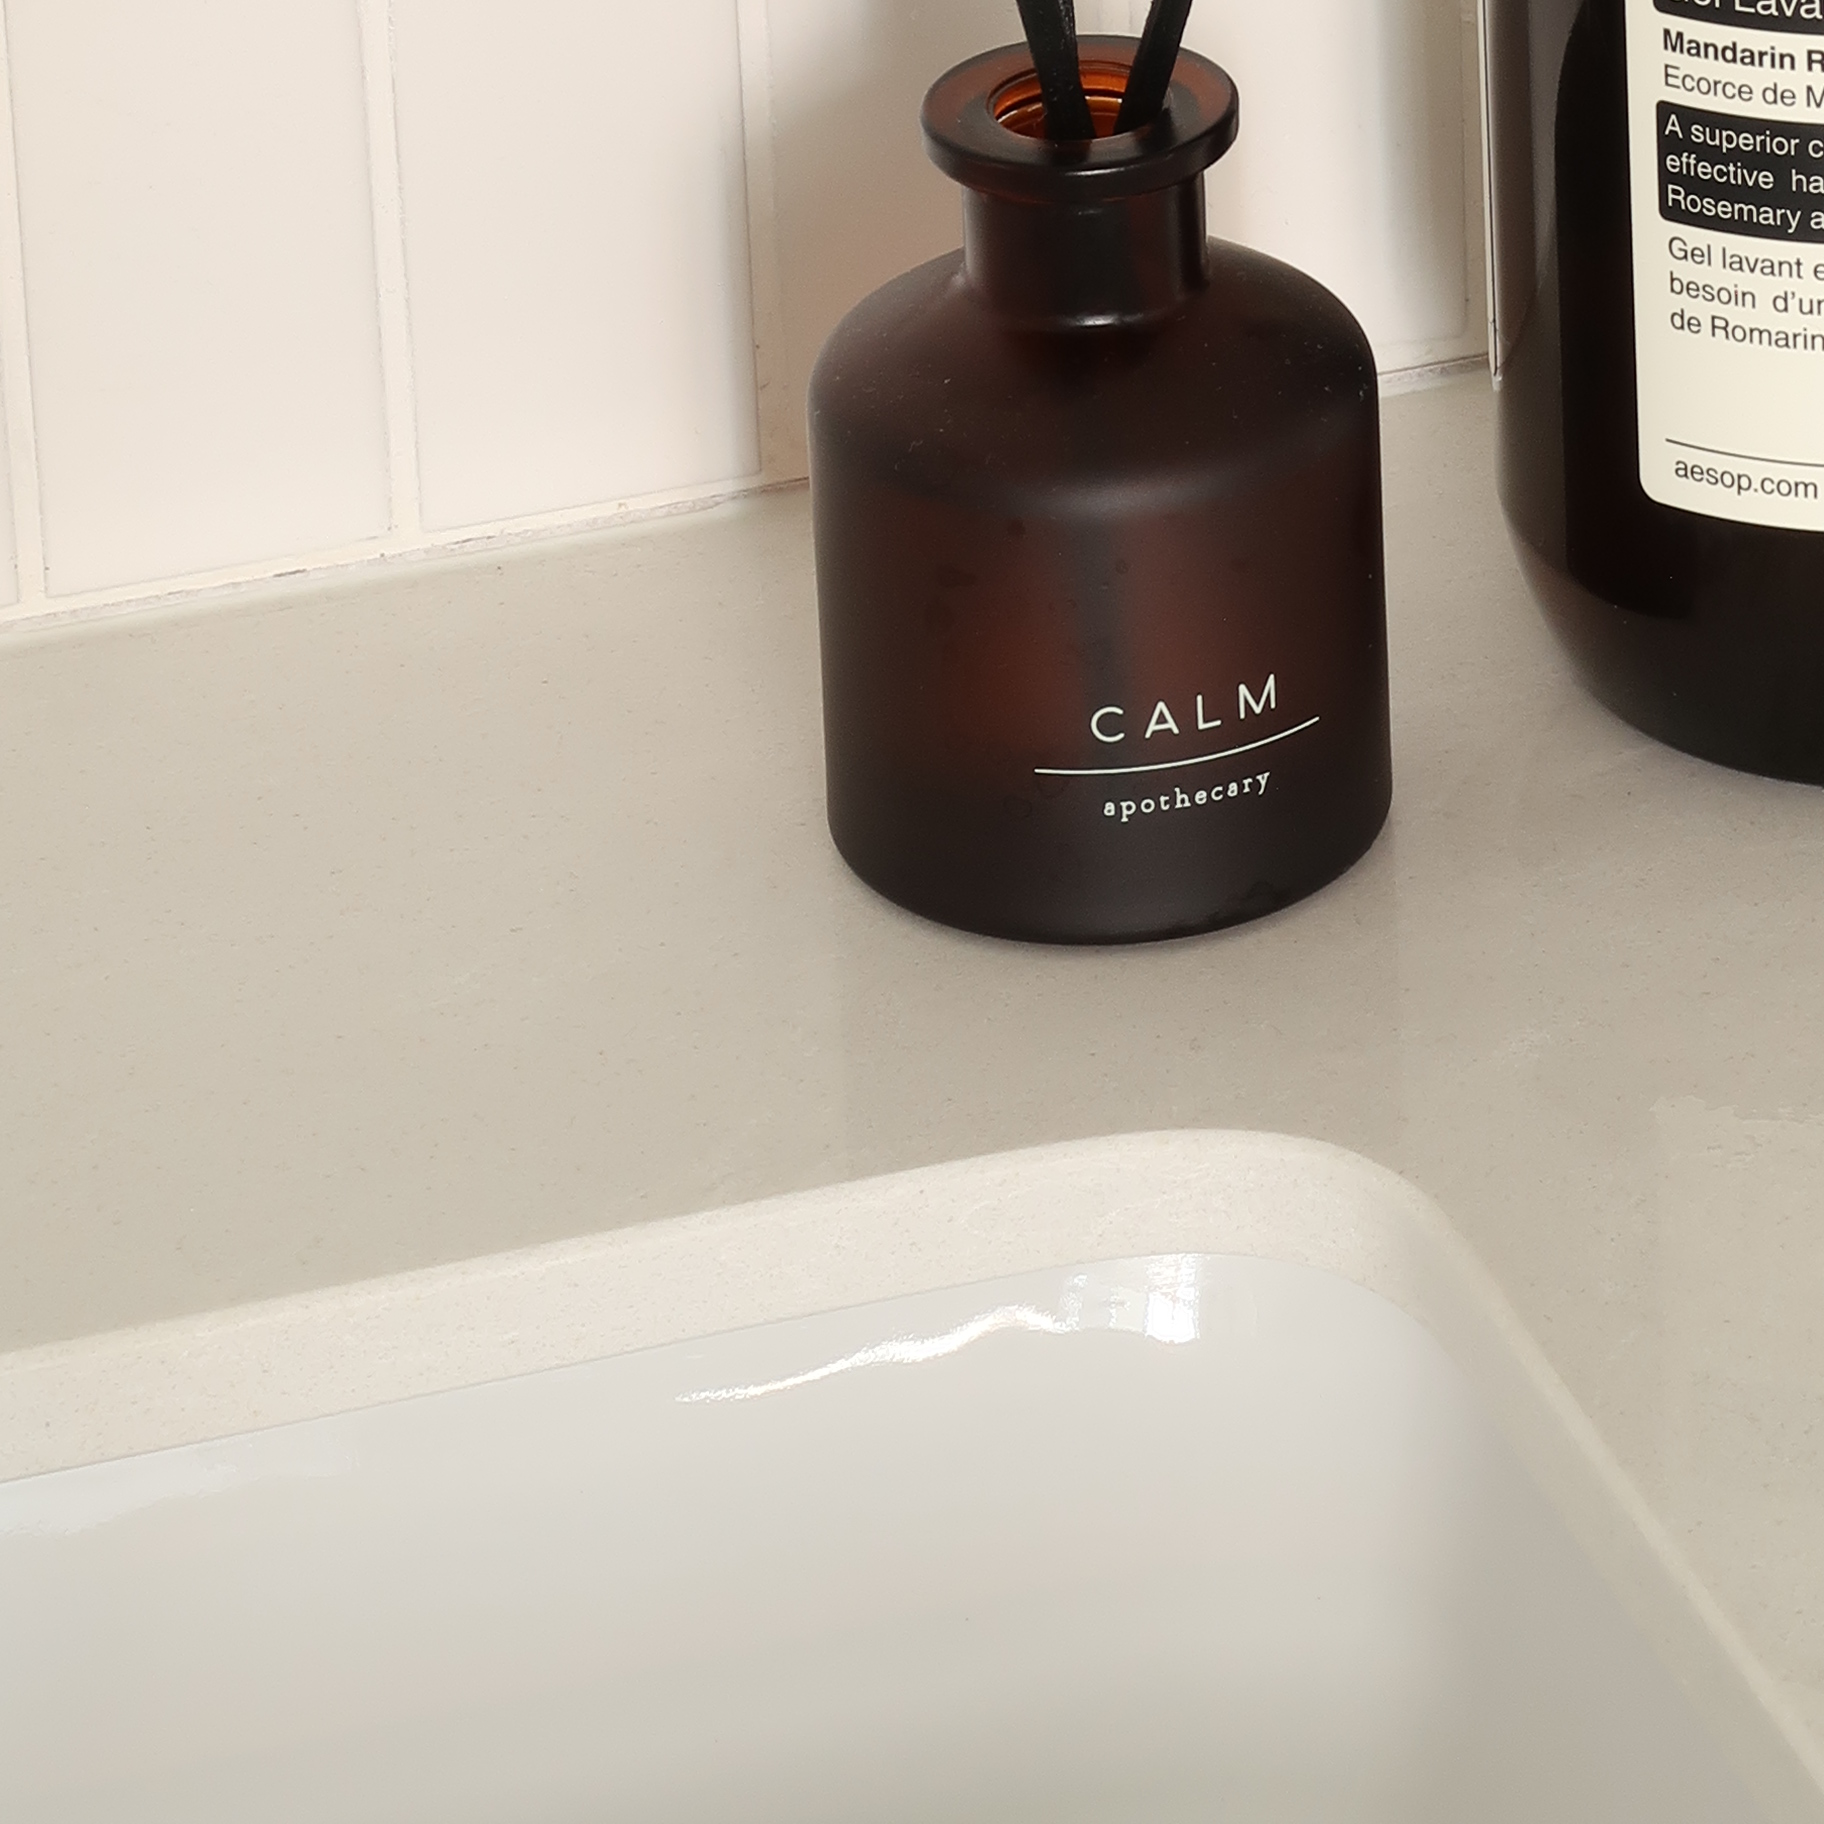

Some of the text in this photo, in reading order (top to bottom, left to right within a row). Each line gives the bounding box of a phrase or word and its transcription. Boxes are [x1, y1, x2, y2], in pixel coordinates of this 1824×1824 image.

[1663, 27, 1797, 71] Mandarin
[1664, 63, 1754, 102] Ecorce
[1762, 82, 1797, 107] de
[1664, 113, 1683, 139] A
[1690, 122, 1800, 156] superior
[1665, 152, 1775, 189] effective
[1667, 184, 1801, 233] Rosemary
[1668, 236, 1711, 267] Gel
[1722, 246, 1804, 280] lavant
[1669, 270, 1757, 309] besoin
[1670, 308, 1701, 334] de
[1674, 459, 1818, 500] aesop.com
[1090, 673, 1276, 743] CALM
[1103, 771, 1270, 822] apothecary
